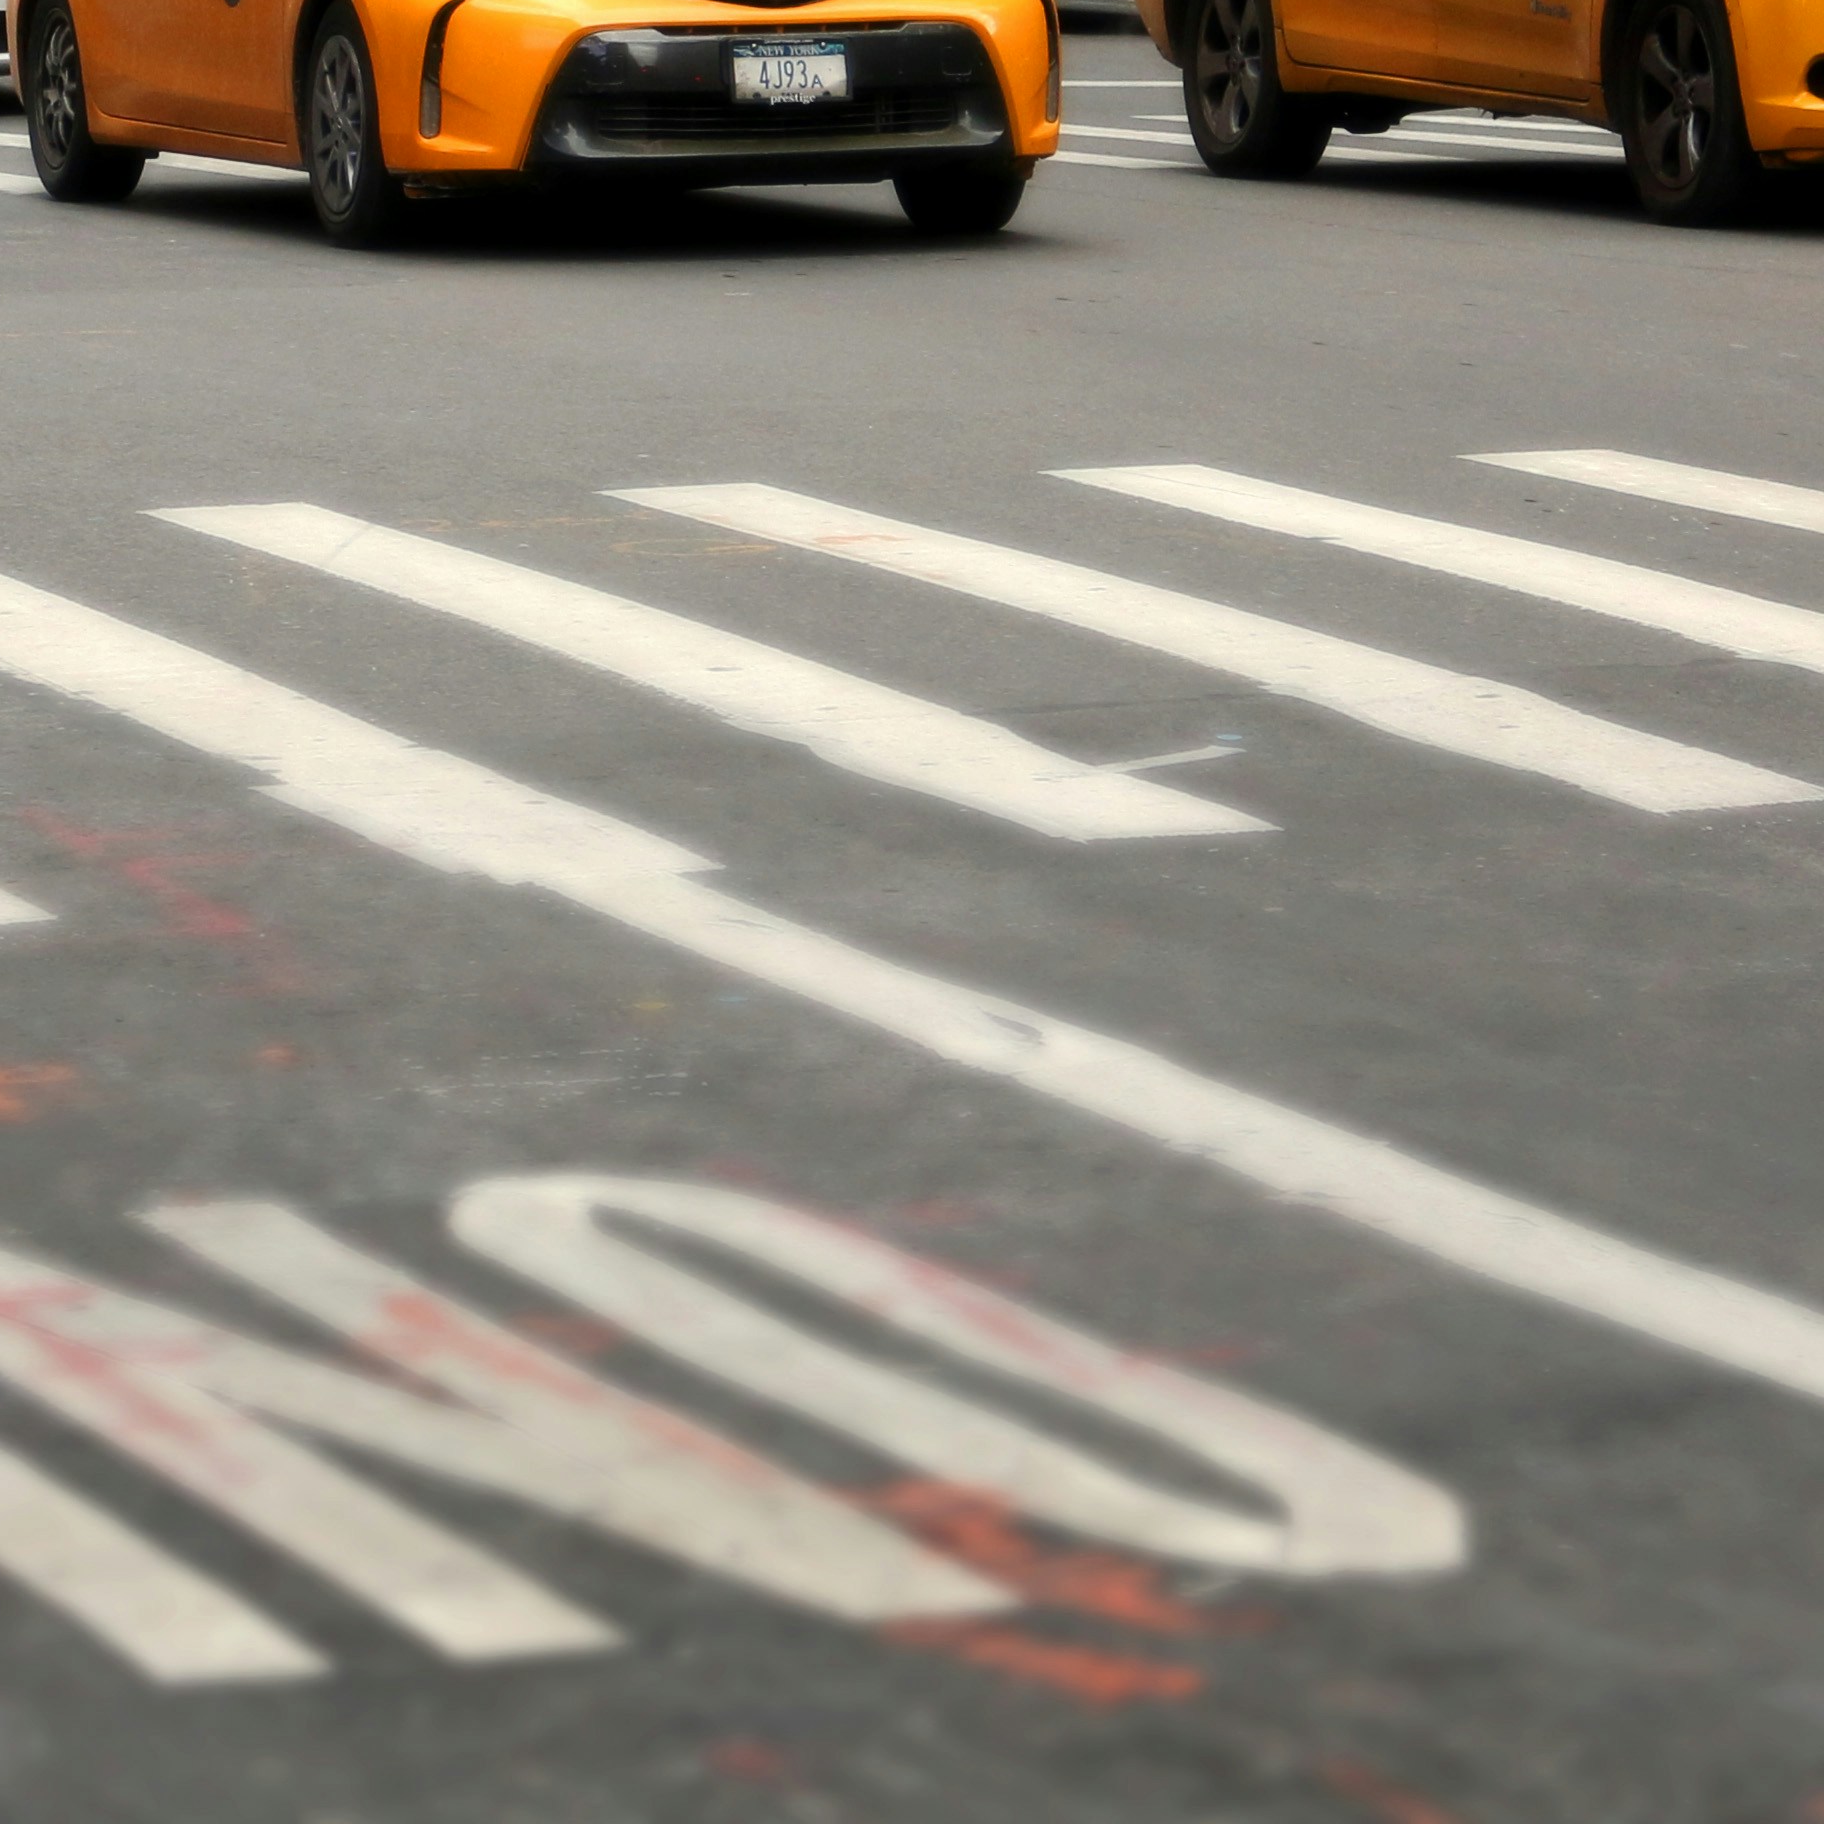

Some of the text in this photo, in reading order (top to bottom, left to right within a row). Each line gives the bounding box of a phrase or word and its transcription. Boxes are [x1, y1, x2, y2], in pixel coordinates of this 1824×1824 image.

[759, 44, 819, 56] NEW YORK
[770, 92, 817, 106] prestige
